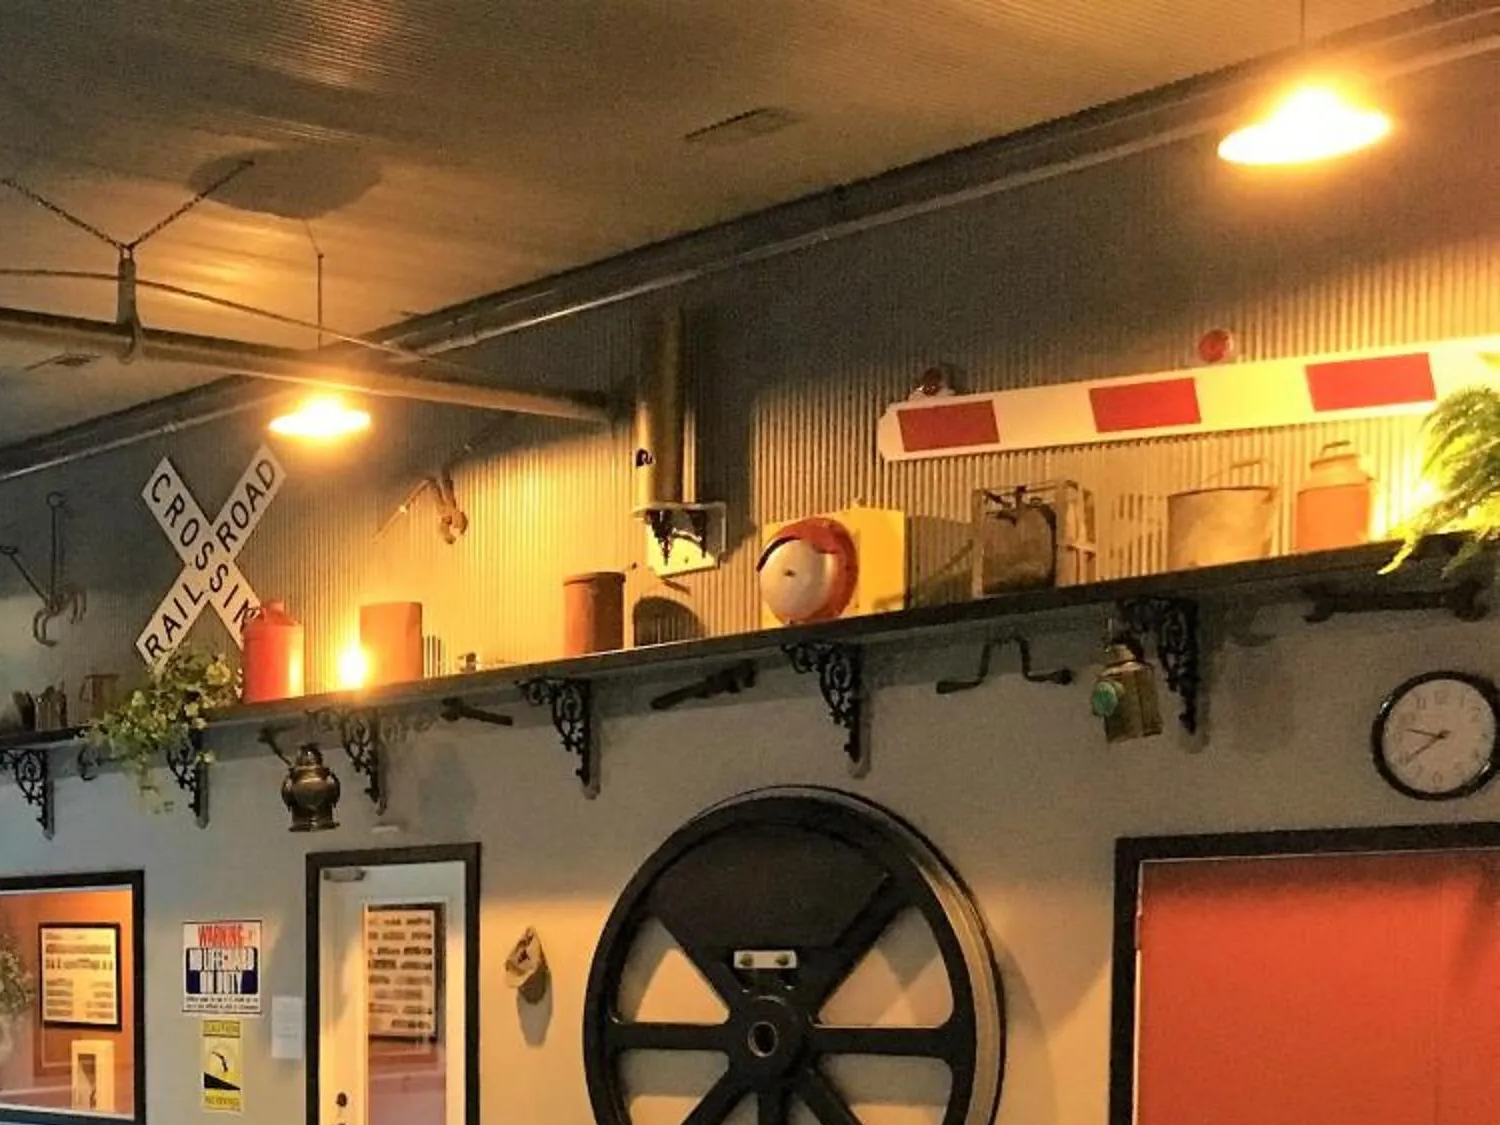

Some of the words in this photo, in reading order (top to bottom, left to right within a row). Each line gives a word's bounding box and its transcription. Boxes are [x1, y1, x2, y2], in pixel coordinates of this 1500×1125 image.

[144, 582, 204, 659] RAIL
[215, 459, 276, 553] ROAD
[151, 472, 254, 632] CROSSIN
